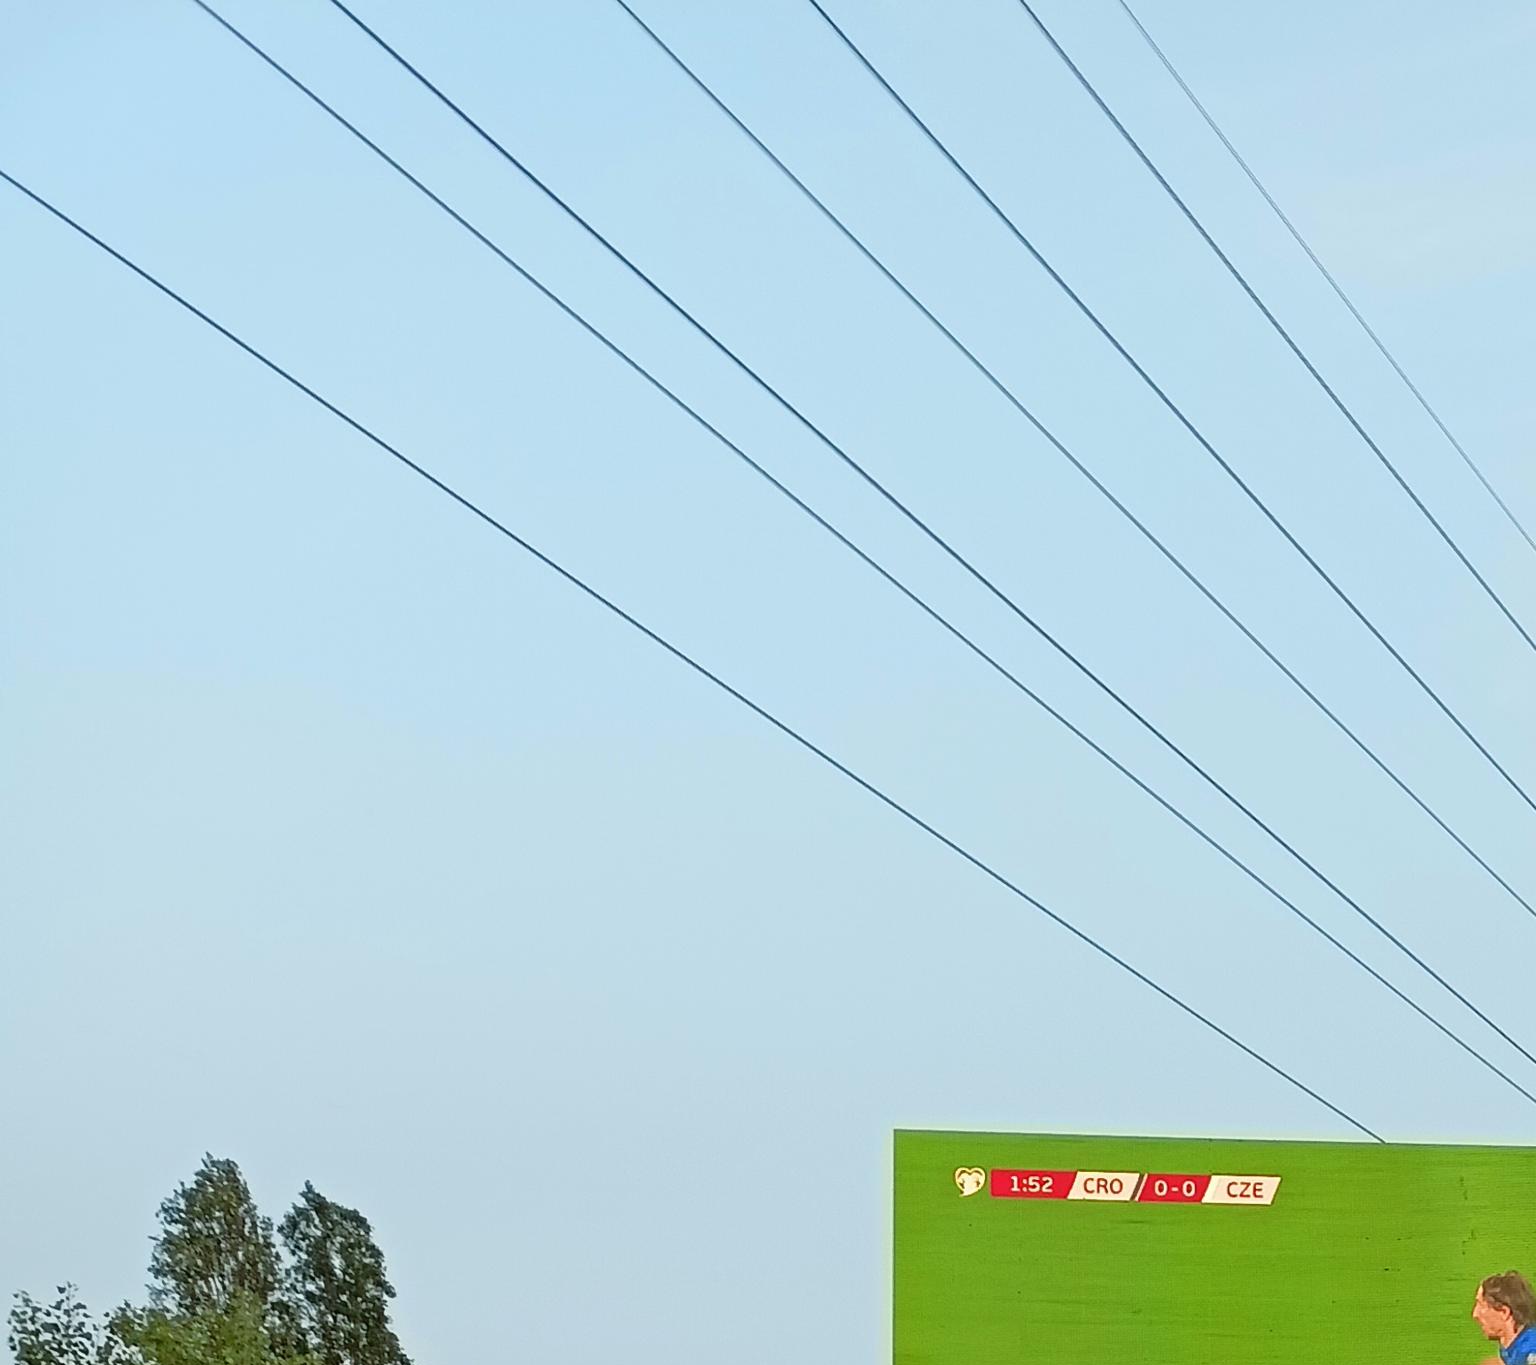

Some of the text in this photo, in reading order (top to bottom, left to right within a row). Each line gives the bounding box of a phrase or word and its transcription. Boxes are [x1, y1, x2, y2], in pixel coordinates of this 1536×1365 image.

[1009, 1175, 1054, 1194] 1:52
[1082, 1177, 1123, 1195] CRO
[1226, 1181, 1264, 1199] CZE
